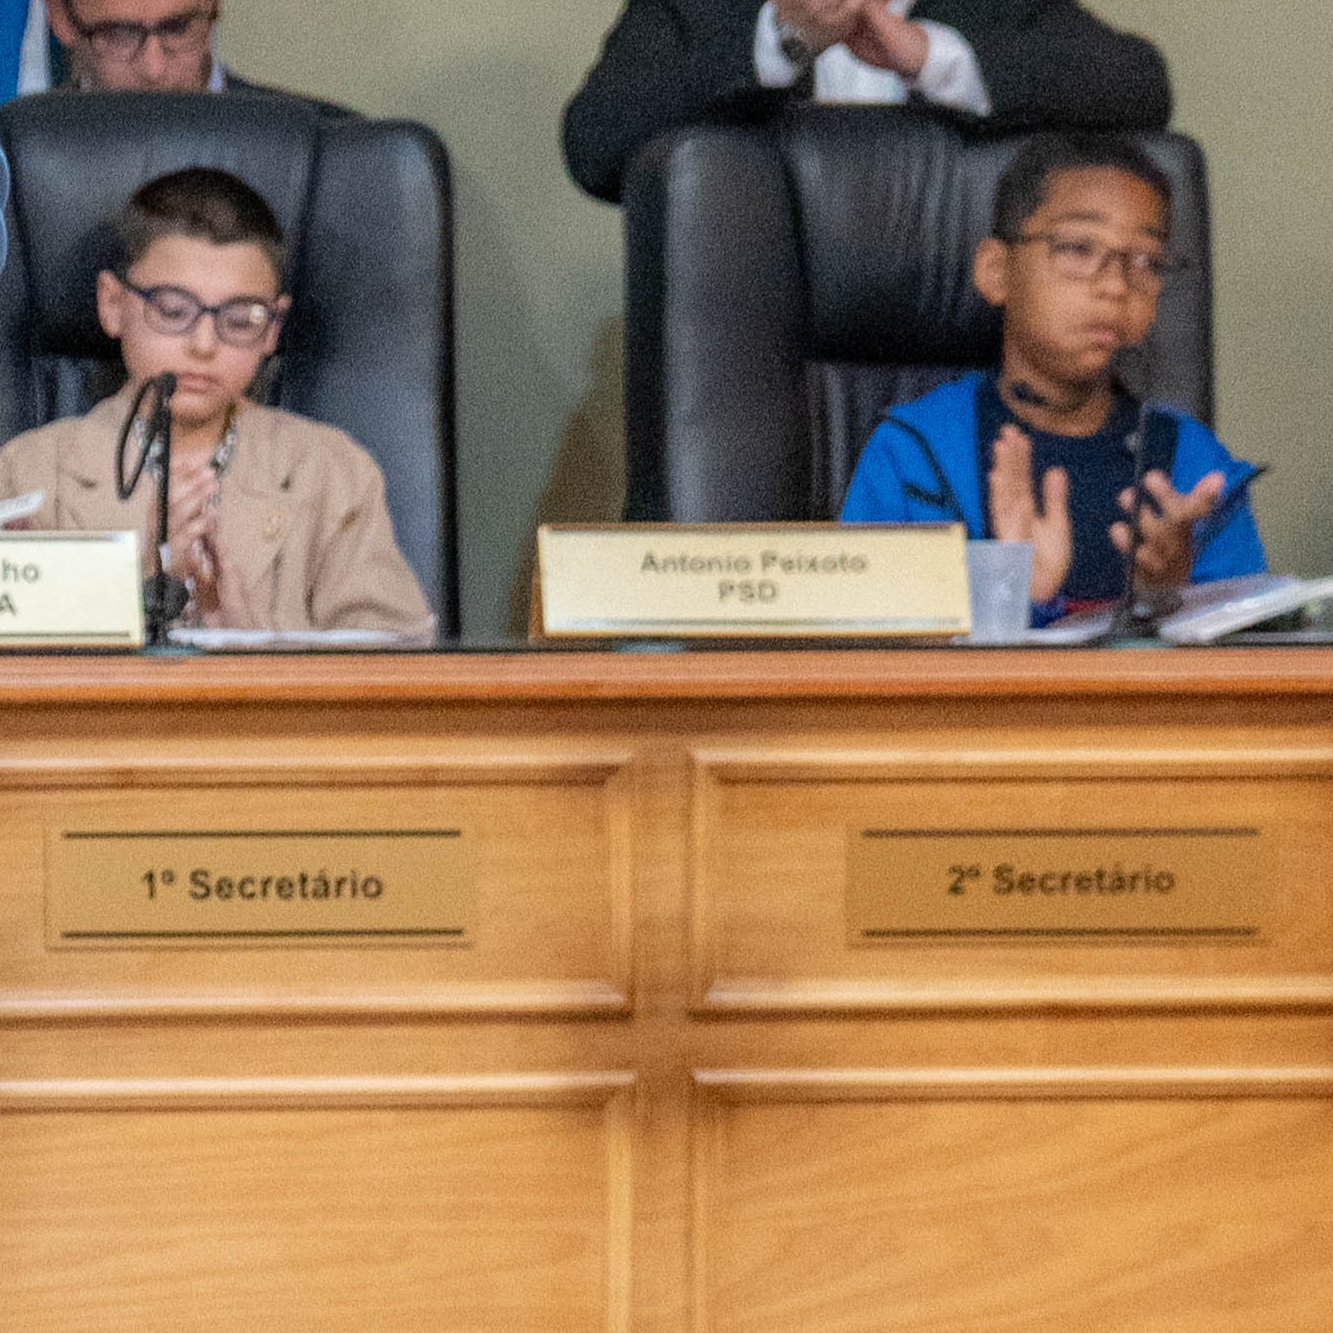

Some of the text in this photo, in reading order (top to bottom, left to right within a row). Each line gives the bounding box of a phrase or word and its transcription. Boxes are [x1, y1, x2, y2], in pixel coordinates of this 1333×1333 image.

[760, 550, 868, 574] Peixoto
[717, 579, 779, 603] PSD
[189, 867, 384, 901] Secretário
[992, 862, 1176, 896] Secretário
